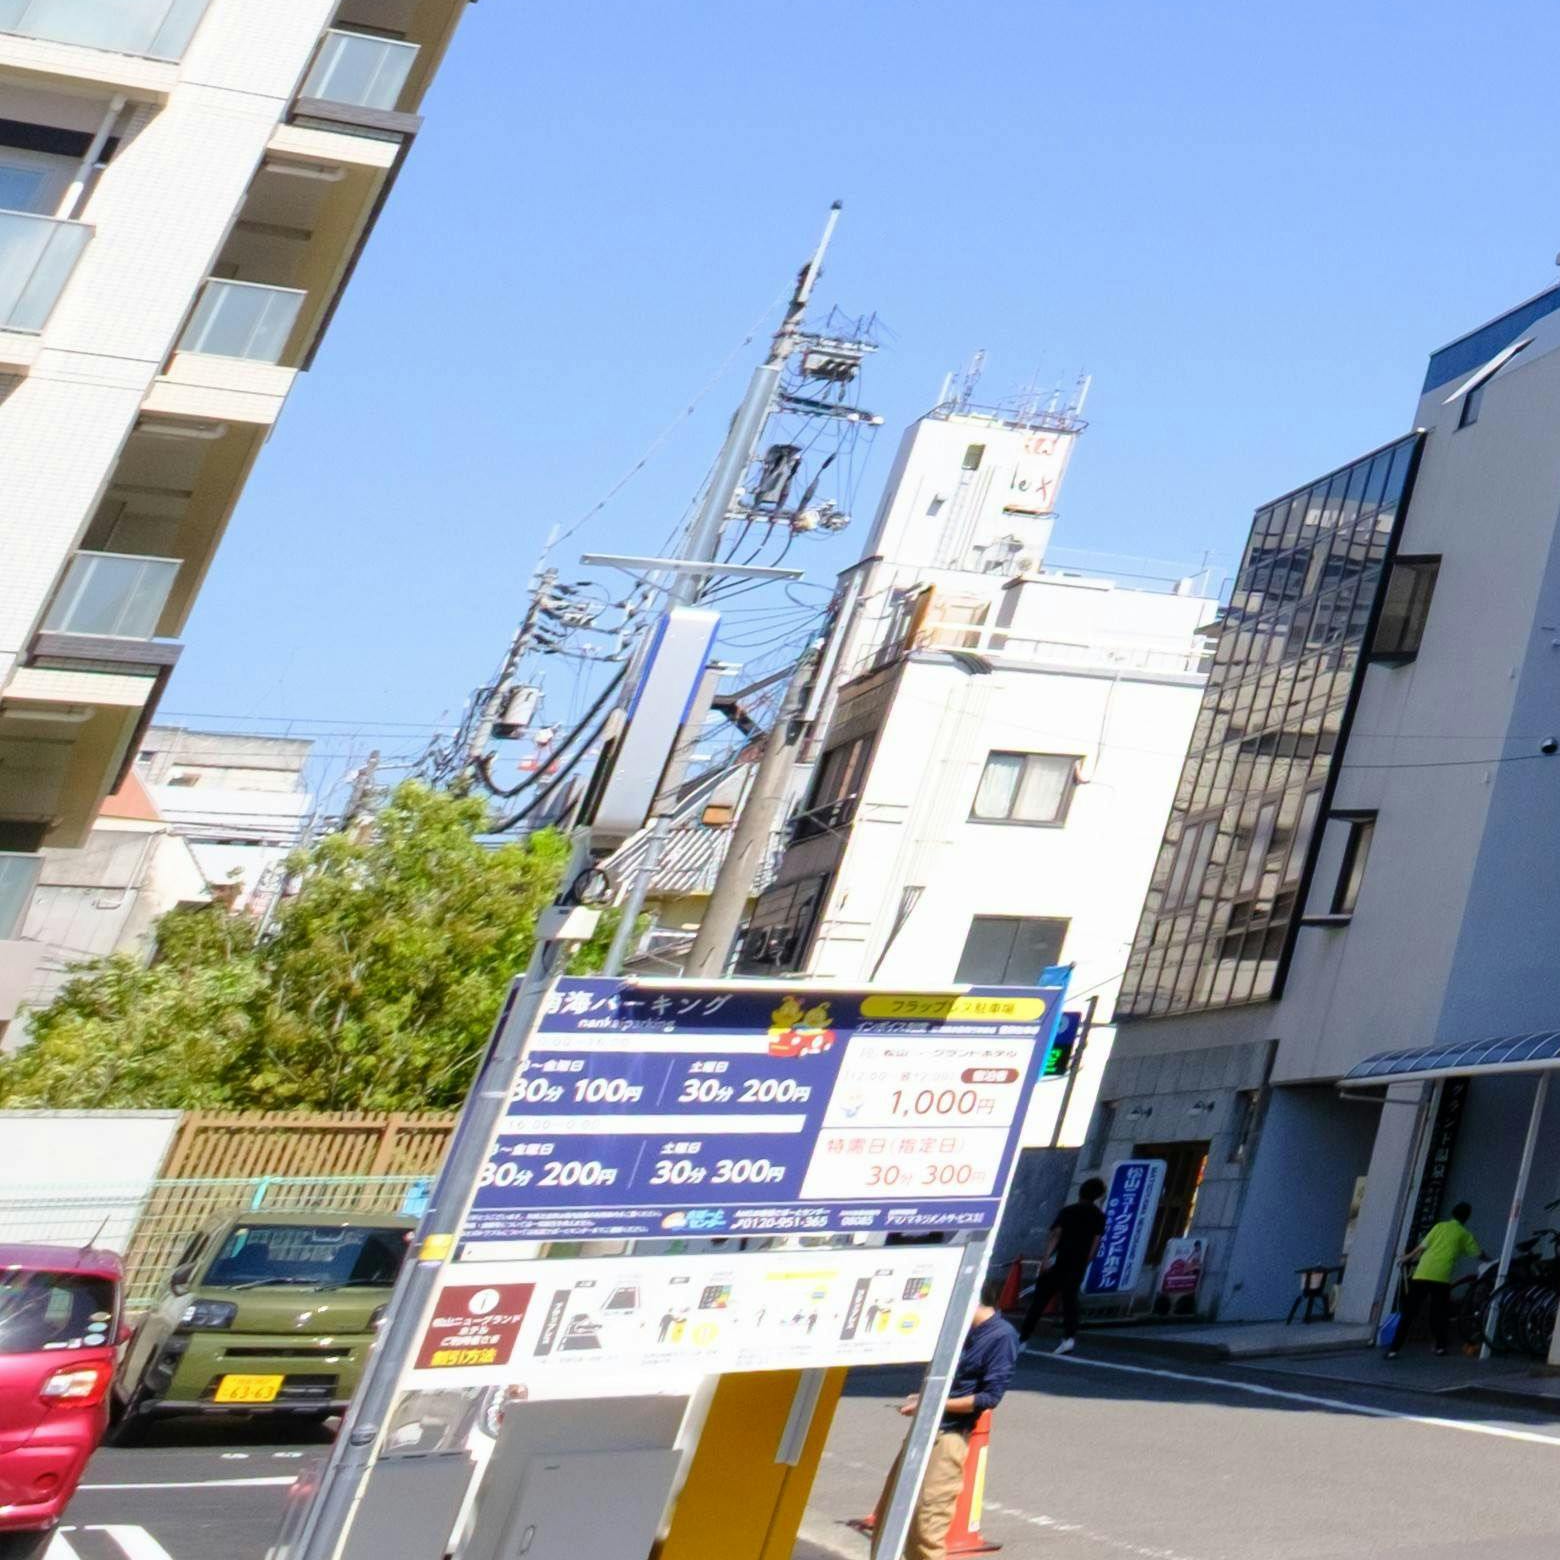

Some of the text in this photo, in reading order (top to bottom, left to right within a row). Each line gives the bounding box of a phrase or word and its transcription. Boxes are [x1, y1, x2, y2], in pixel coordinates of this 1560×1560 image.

[574, 1077, 645, 1104] 100円
[678, 1078, 734, 1104] 30分
[737, 1078, 812, 1103] 200円
[891, 1089, 997, 1117] 1,000円
[537, 1160, 618, 1187] 200円
[649, 1160, 708, 1185] 30分
[711, 1158, 787, 1184] 300円
